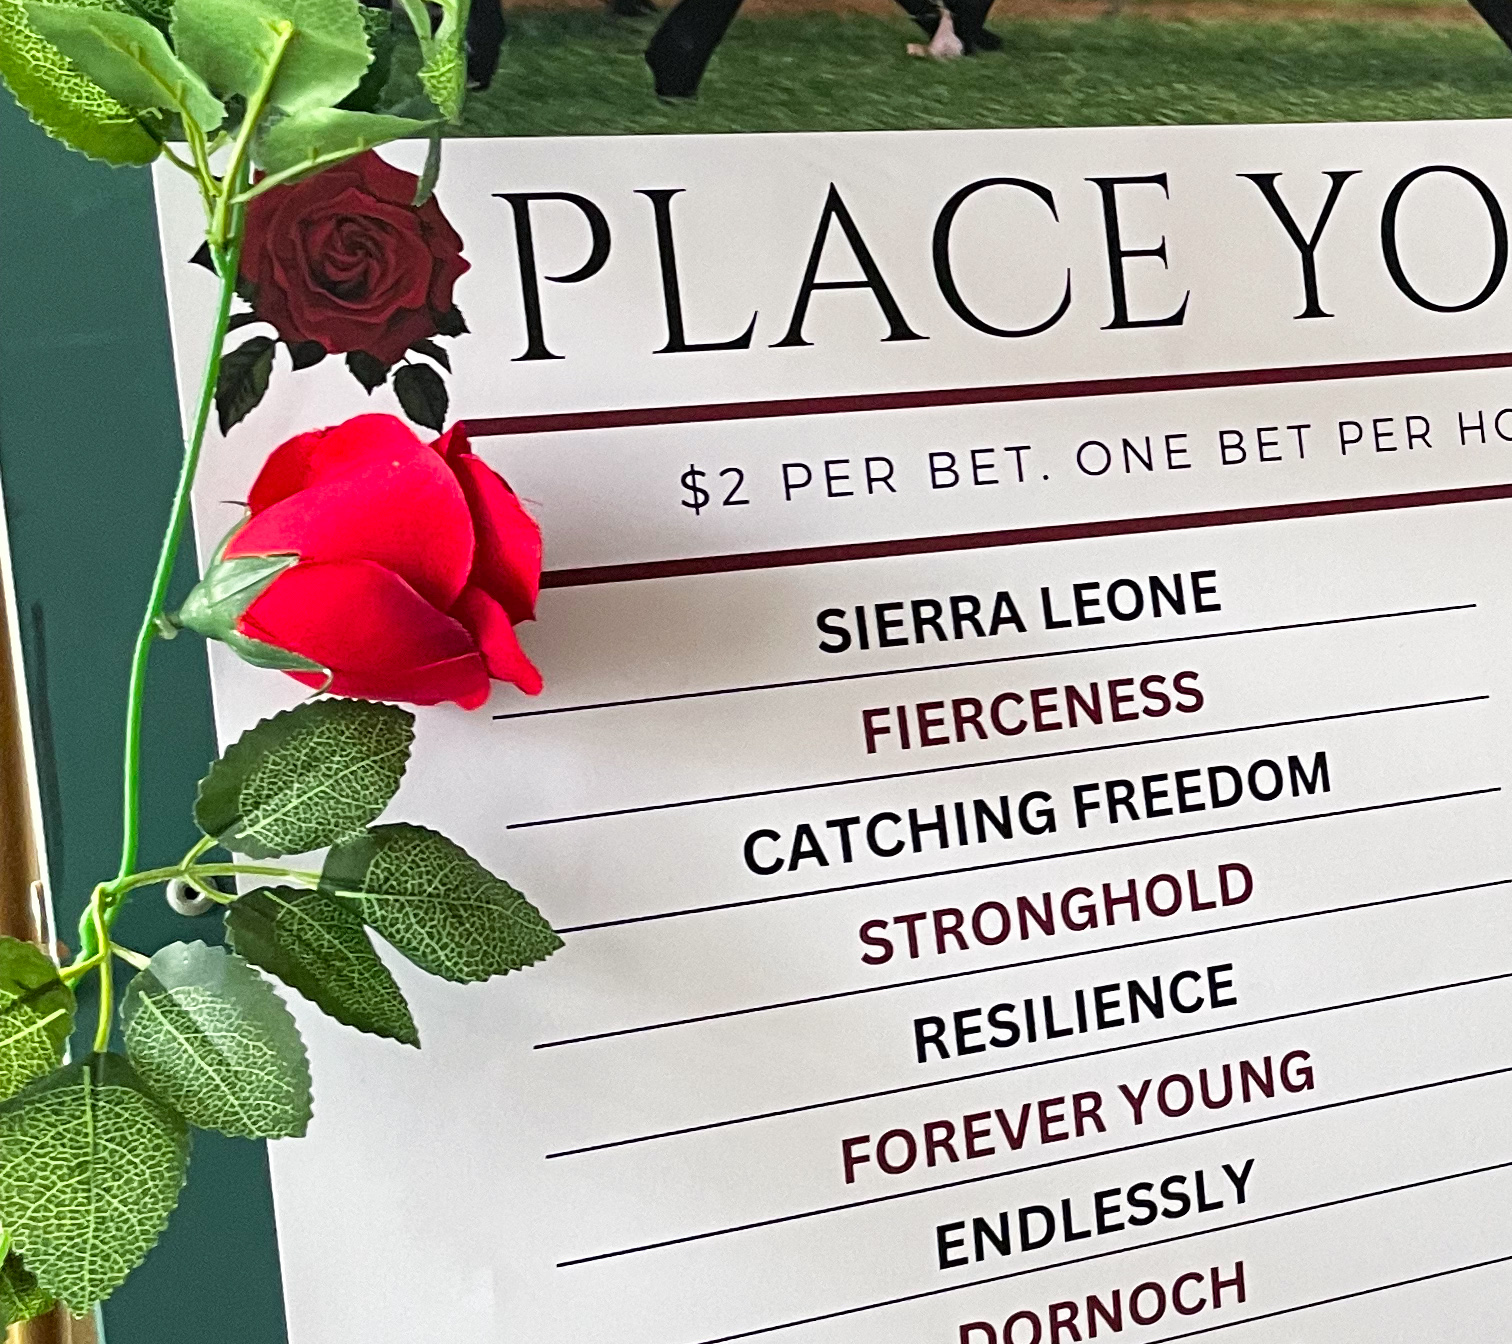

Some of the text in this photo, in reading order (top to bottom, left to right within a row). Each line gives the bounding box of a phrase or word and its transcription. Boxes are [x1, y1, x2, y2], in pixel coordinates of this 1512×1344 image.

[492, 172, 1191, 362] PLACE
[679, 465, 751, 516] $2
[782, 455, 899, 502] PER
[929, 444, 1051, 490] BET.
[1075, 432, 1193, 477] ONE
[1219, 422, 1313, 466] BET
[1339, 413, 1435, 455] PER
[816, 569, 1222, 654] SIERRA LEONE
[862, 670, 1205, 754] FIERCENESS
[742, 751, 1332, 876] CATCHING FREEDOM
[858, 862, 1255, 966] STRONGHOLD
[913, 963, 1238, 1064] RESILIENCE
[841, 1049, 1316, 1185] FOREVER YOUNG
[935, 1158, 1256, 1270] ENDLESSLY
